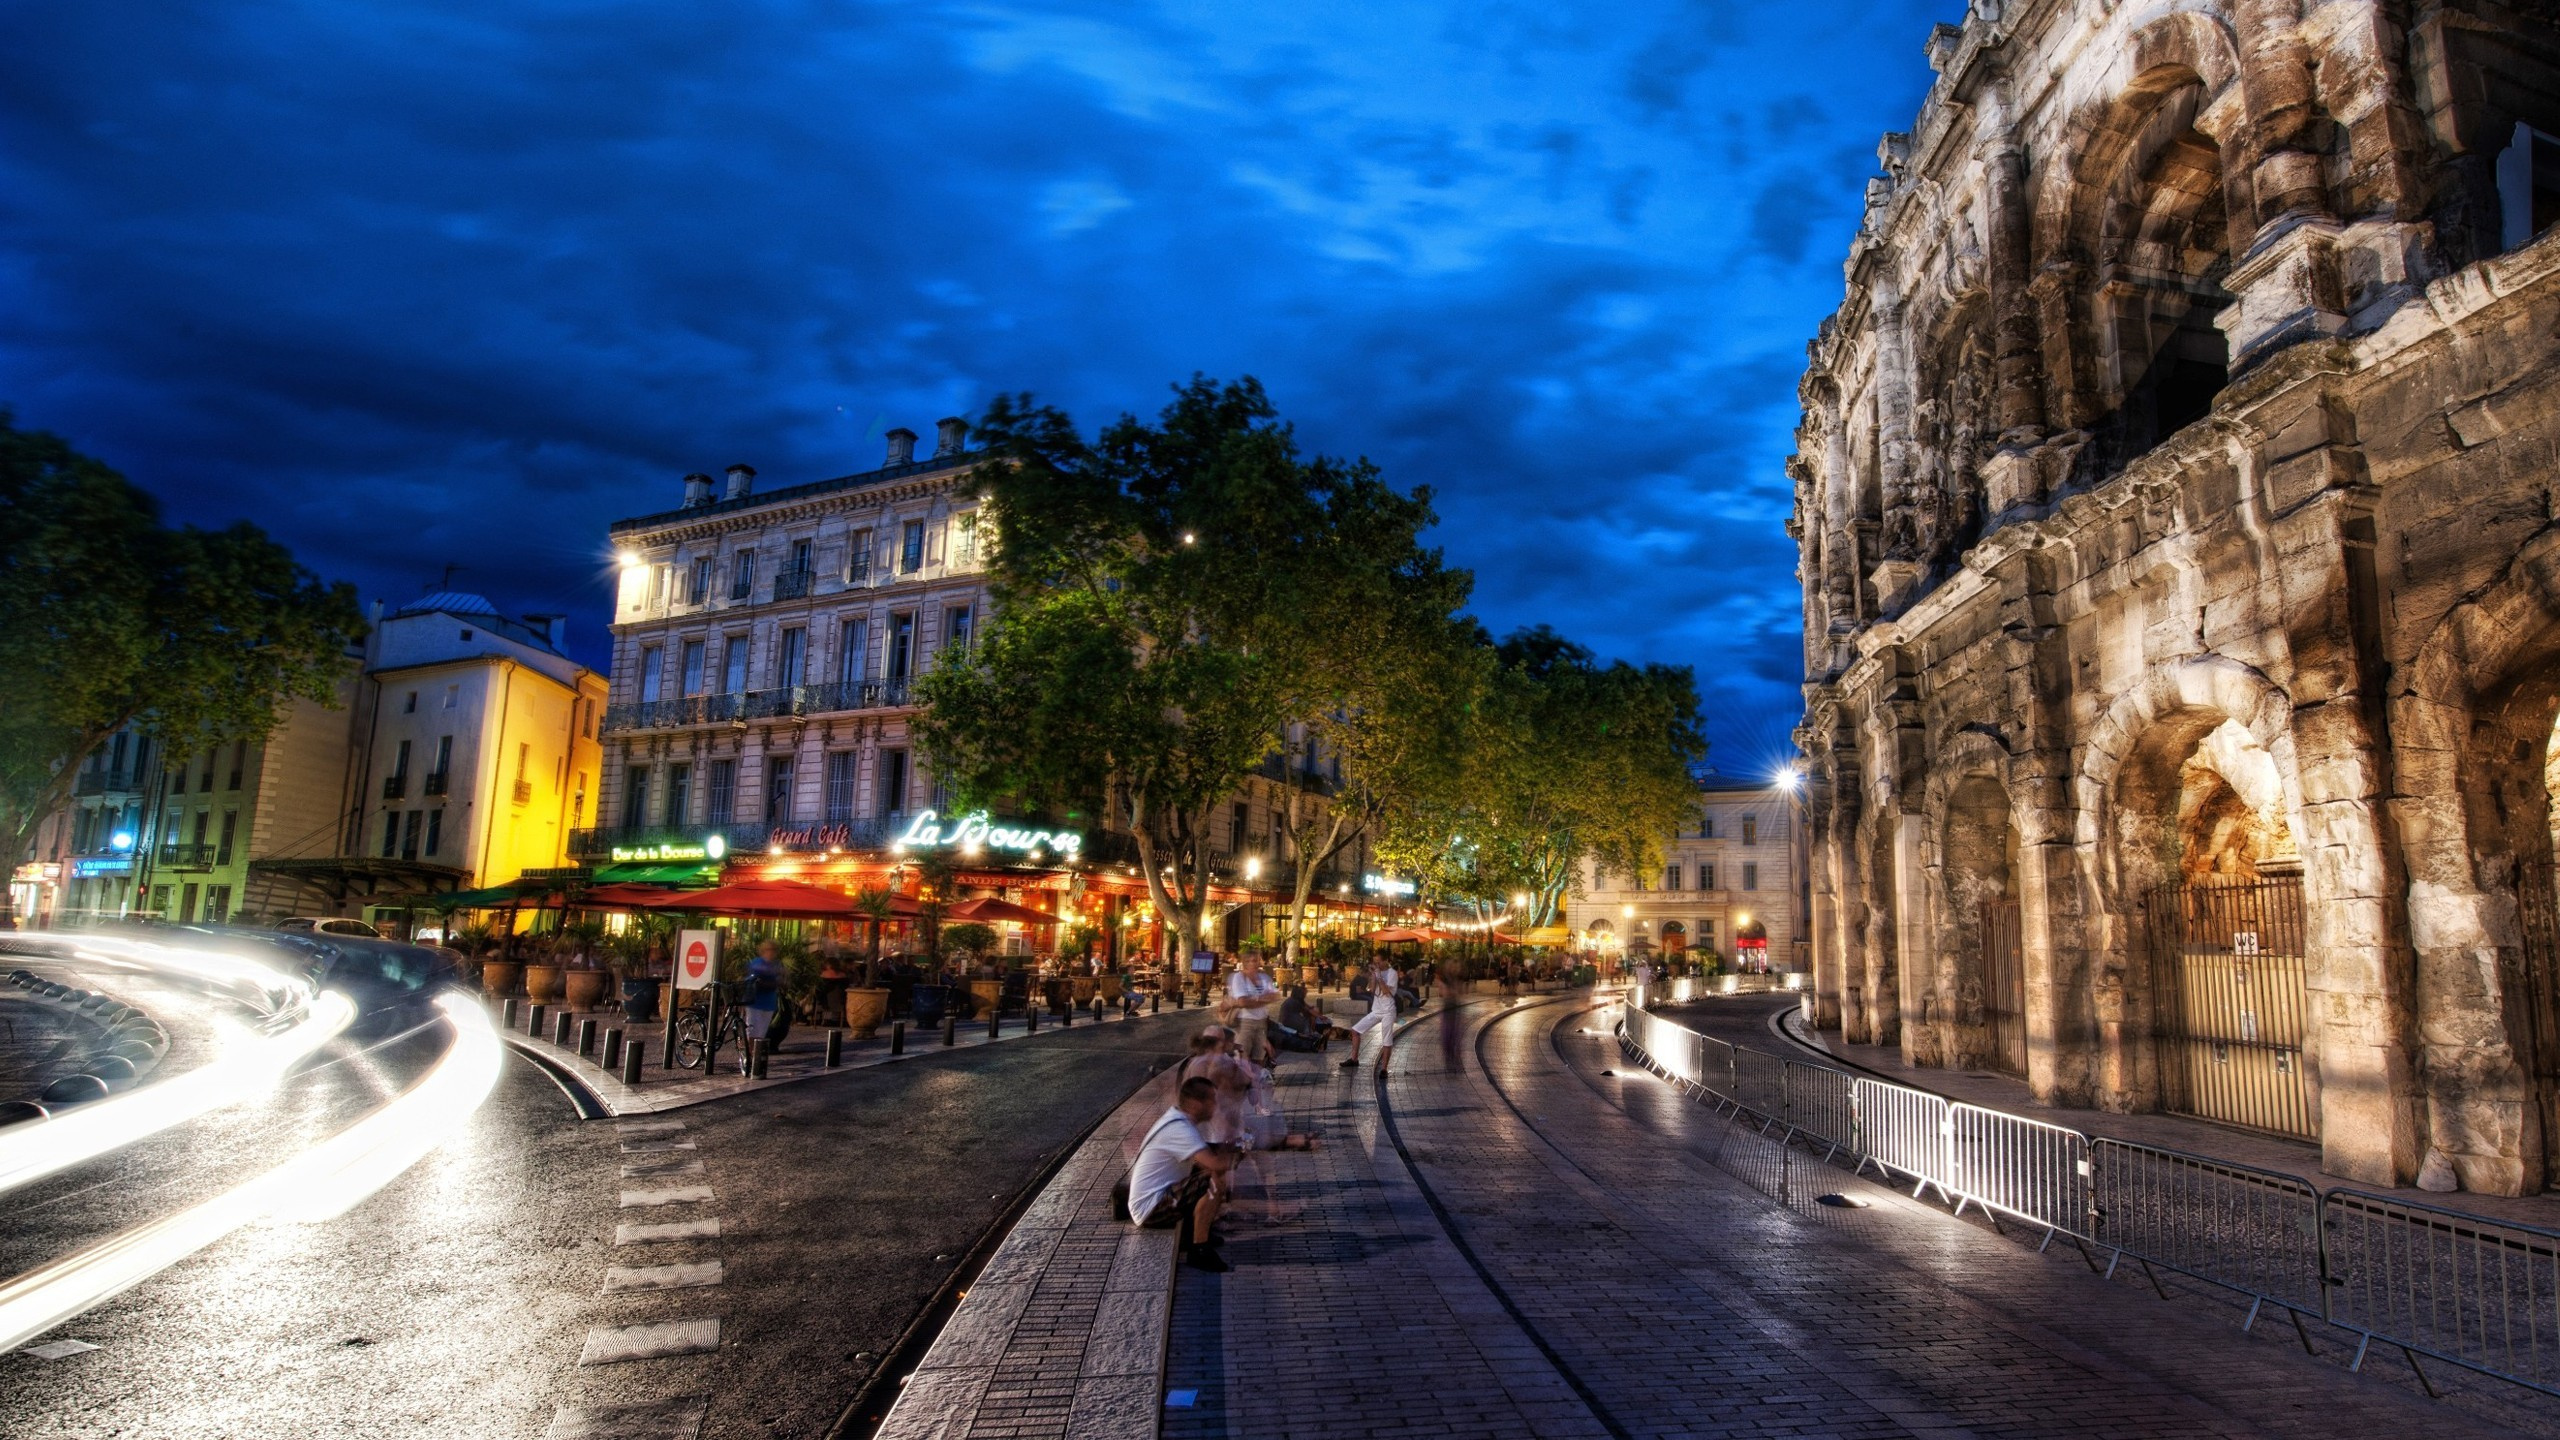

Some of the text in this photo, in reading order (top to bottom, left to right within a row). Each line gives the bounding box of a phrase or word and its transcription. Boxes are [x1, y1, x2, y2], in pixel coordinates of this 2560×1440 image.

[770, 823, 850, 845] Grand Café
[897, 809, 941, 846] La
[612, 844, 705, 861] Bar de la Bourse
[2235, 935, 2256, 947] WC
